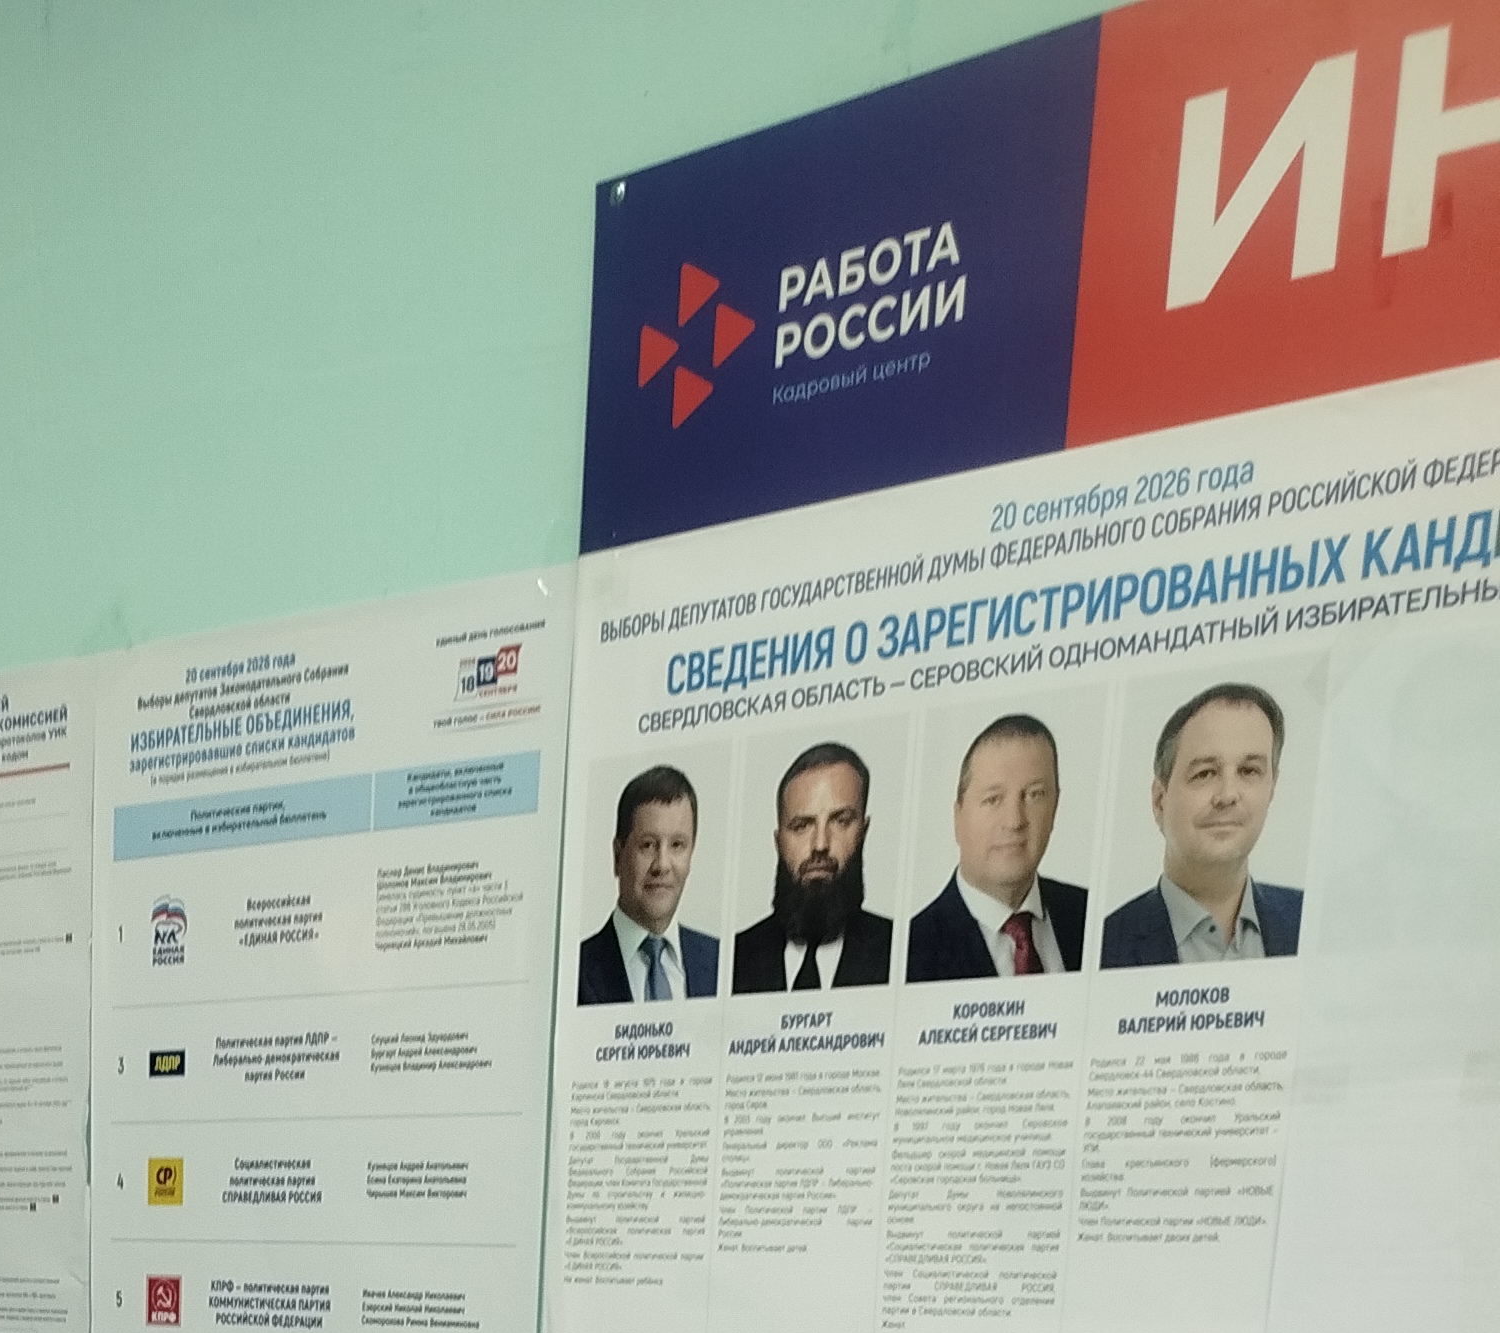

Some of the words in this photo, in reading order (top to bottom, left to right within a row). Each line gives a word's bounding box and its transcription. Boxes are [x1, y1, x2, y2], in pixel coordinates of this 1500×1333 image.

[778, 220, 960, 312] РАБОТА
[775, 274, 967, 369] РОССИИ
[772, 364, 867, 404] Кадровый
[873, 352, 931, 381] центр
[990, 501, 1016, 532] 20
[1023, 484, 1127, 526] сентября
[1134, 467, 1190, 505] 2026
[1197, 460, 1254, 492] года
[600, 610, 665, 643] ВЫБОРЫ
[668, 592, 757, 633] ДЕПУТАТОВ
[760, 553, 924, 611] ГОСУДАРСТВЕННОЙ
[927, 547, 985, 583] ДУМЫ
[990, 516, 1146, 568] ФЕДЕРАЛЬНОГО
[1151, 495, 1262, 537] СОБРАНИЯ
[1267, 459, 1417, 516] РОССИЙСКОЙ
[666, 625, 835, 696] СВЕДЕНИЯ
[845, 620, 868, 664] О
[876, 533, 1351, 659] ЗАРЕГИСТРИРОВАННЫХ
[1361, 509, 1500, 580] КАНД
[497, 651, 517, 670] 20
[638, 690, 787, 733] СВЕРДЛОВСКАЯ
[791, 675, 885, 709] ОБЛАСТЬ
[909, 643, 1043, 691] СЕРОВСКИЙ
[1048, 605, 1278, 669] ОДНОМАНДАТНЫЙ
[220, 671, 302, 696] Законодательного
[304, 663, 349, 683] Собрания
[253, 692, 291, 708] области
[130, 715, 242, 753] ИЗБИРАТЕЛЬНЫЕ
[246, 698, 355, 734] ОБЪЕДИНЕНИЯ,
[129, 744, 242, 774] зарегистрировавшие
[245, 738, 285, 756] списки
[288, 727, 356, 749] кандидатов
[1155, 986, 1230, 1008] МОЛОКОВ
[780, 1011, 833, 1030] БУРГАРТ
[953, 1000, 1025, 1020] КОРОВКИН
[614, 1022, 674, 1040] БИДОНЬКО
[918, 1022, 978, 1045] АЛЕКСЕЙ
[980, 1022, 1058, 1043] СЕРГЕЕВИЧ
[1118, 1011, 1186, 1035] ВАЛЕРИЙ
[1189, 1011, 1265, 1033] ЮРЬЕВИЧ
[595, 1043, 635, 1063] СЕРГЕЙ
[637, 1043, 691, 1061] ЮРЬЕВИЧ
[728, 1036, 776, 1056] АНДРЕЙ
[777, 1032, 886, 1053] АЛЕКСАНДРОВИЧ
[154, 1056, 181, 1072] ЛДПР
[116, 1173, 124, 1190] 4
[222, 1190, 287, 1205] СПРАВЕДЛИВАЯ
[288, 1190, 322, 1203] РОССИЯ
[116, 1290, 123, 1308] 5
[209, 1296, 297, 1311] КОММУНИСТИЧЕСКАЯ
[298, 1300, 331, 1312] ПАРТИЯ
[151, 1311, 177, 1323] КПРФ
[215, 1312, 270, 1326] РОССИЙСКОЙ
[271, 1314, 323, 1330] ФЕДЕРАЦИИ
